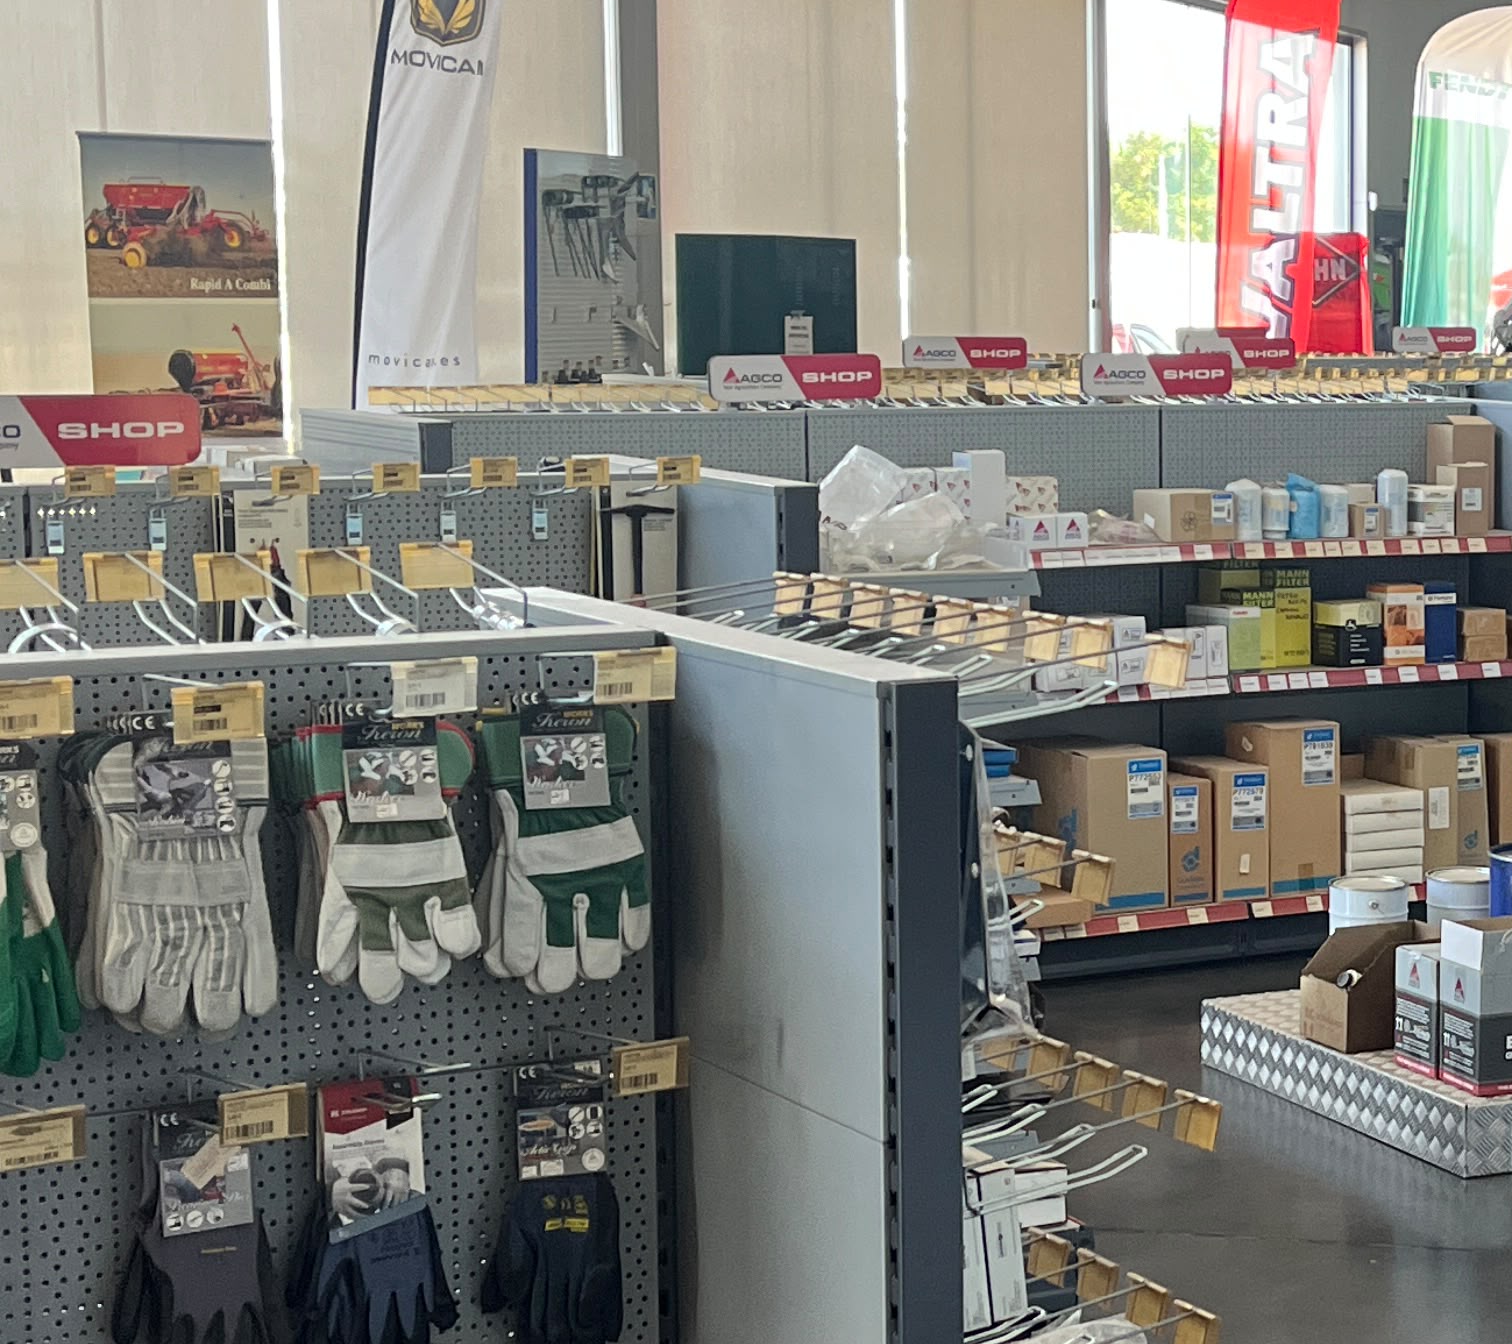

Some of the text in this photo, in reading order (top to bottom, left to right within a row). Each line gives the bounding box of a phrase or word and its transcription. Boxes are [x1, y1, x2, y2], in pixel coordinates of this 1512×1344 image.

[190, 277, 272, 294] Rapid A Combi
[969, 348, 1022, 358] SHOP
[1243, 348, 1290, 358] SHOP
[741, 371, 873, 384] AGCO SHOP
[1162, 368, 1225, 380] SHOP
[57, 421, 185, 440] SHOP
[1276, 570, 1310, 578] MANN
[1276, 578, 1310, 587] FILTER
[1242, 591, 1274, 600] MANN
